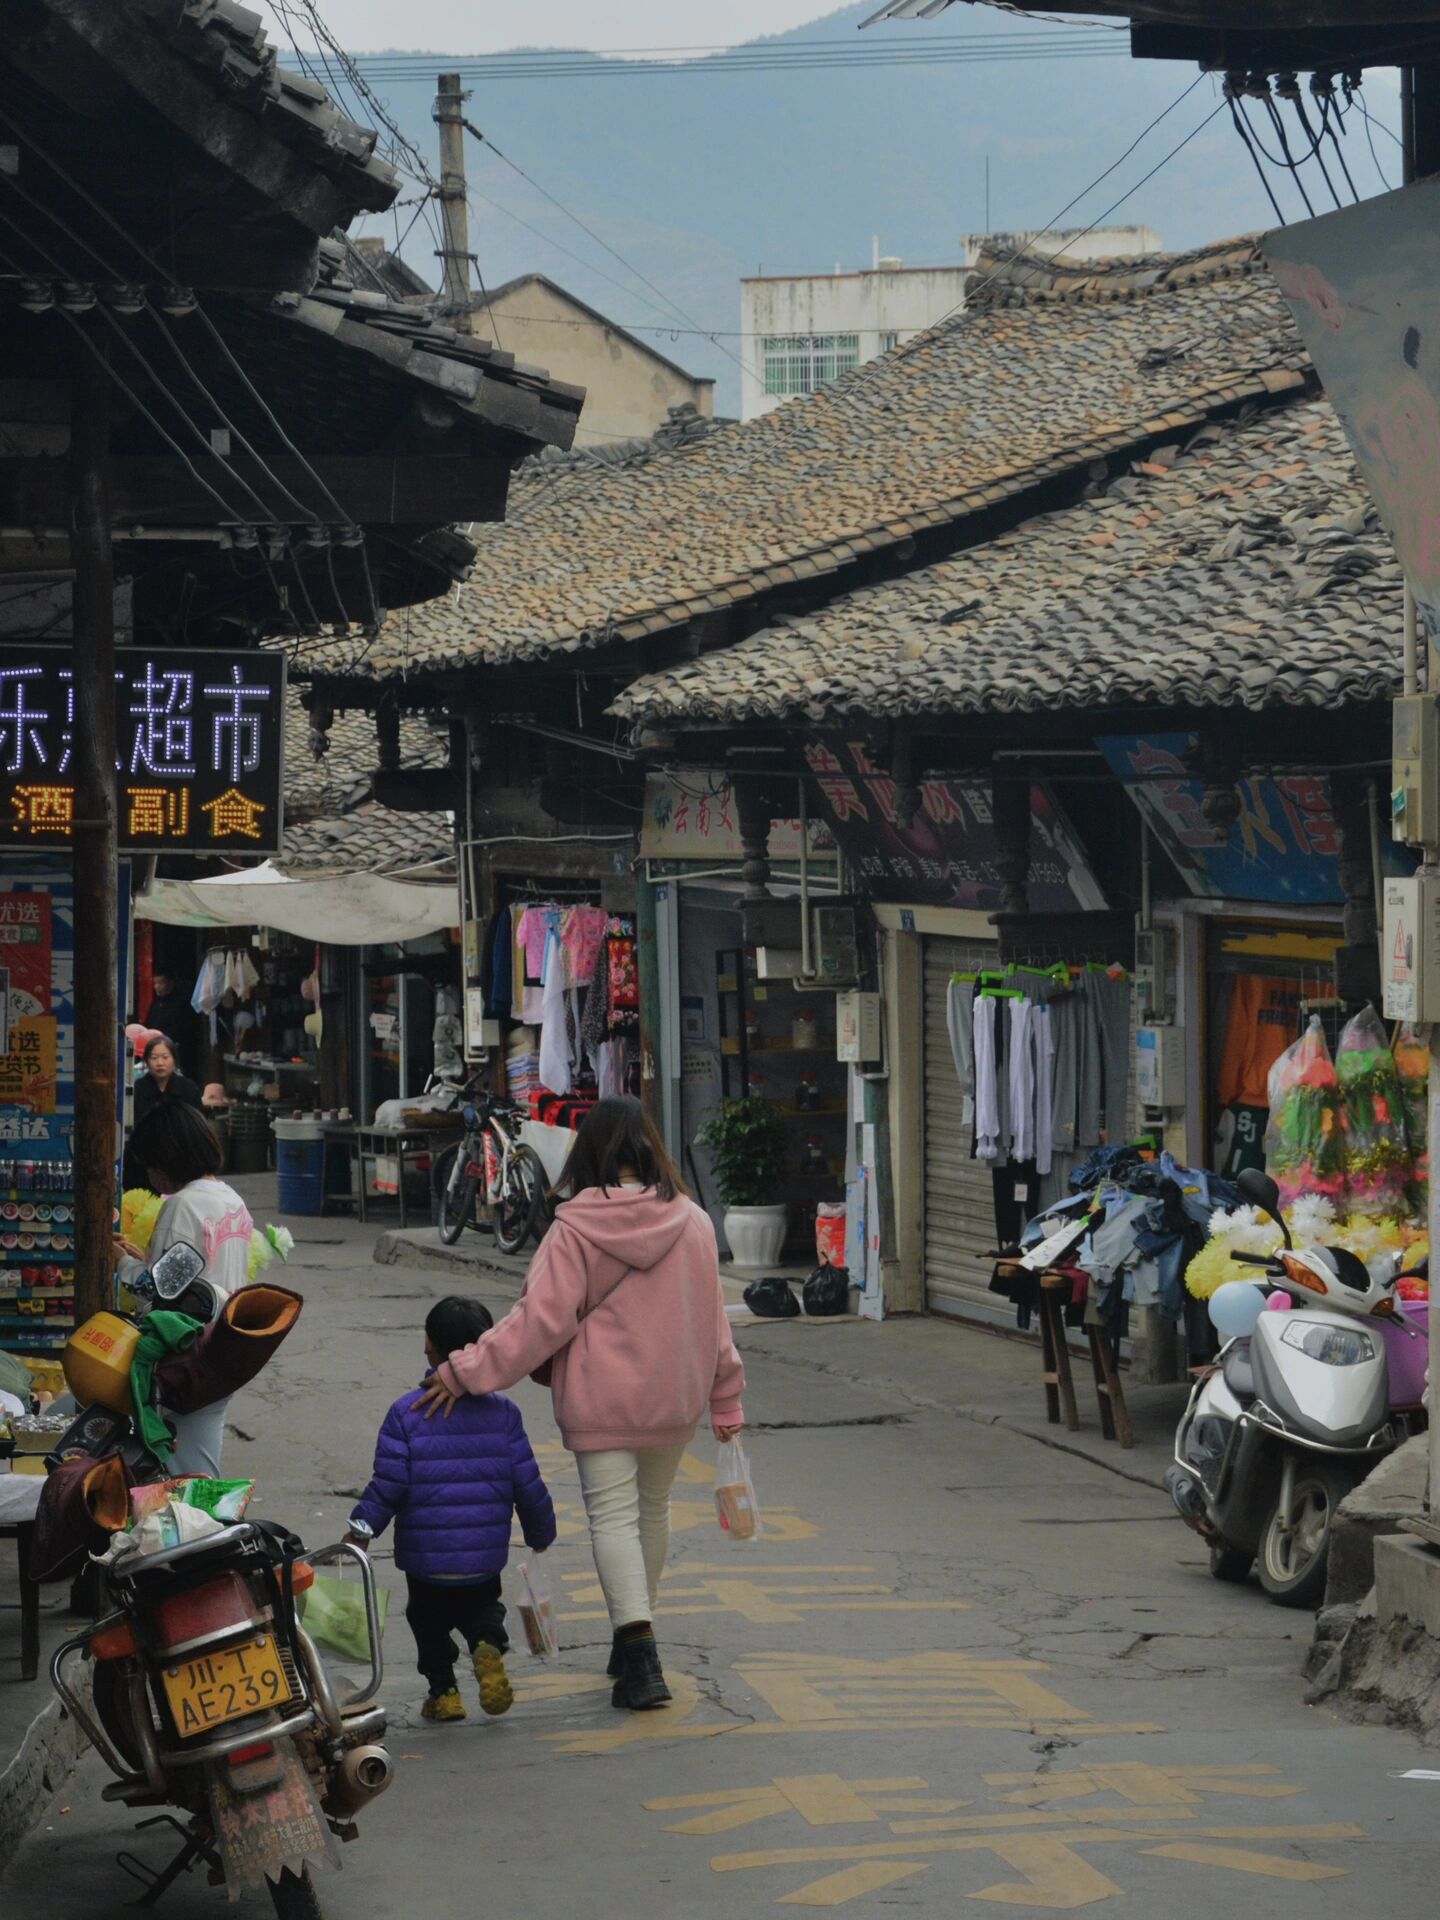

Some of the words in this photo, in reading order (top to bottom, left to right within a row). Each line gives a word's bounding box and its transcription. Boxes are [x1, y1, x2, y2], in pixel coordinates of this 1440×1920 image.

[0, 661, 270, 783] 乐超市
[181, 1669, 280, 1732] AE239
